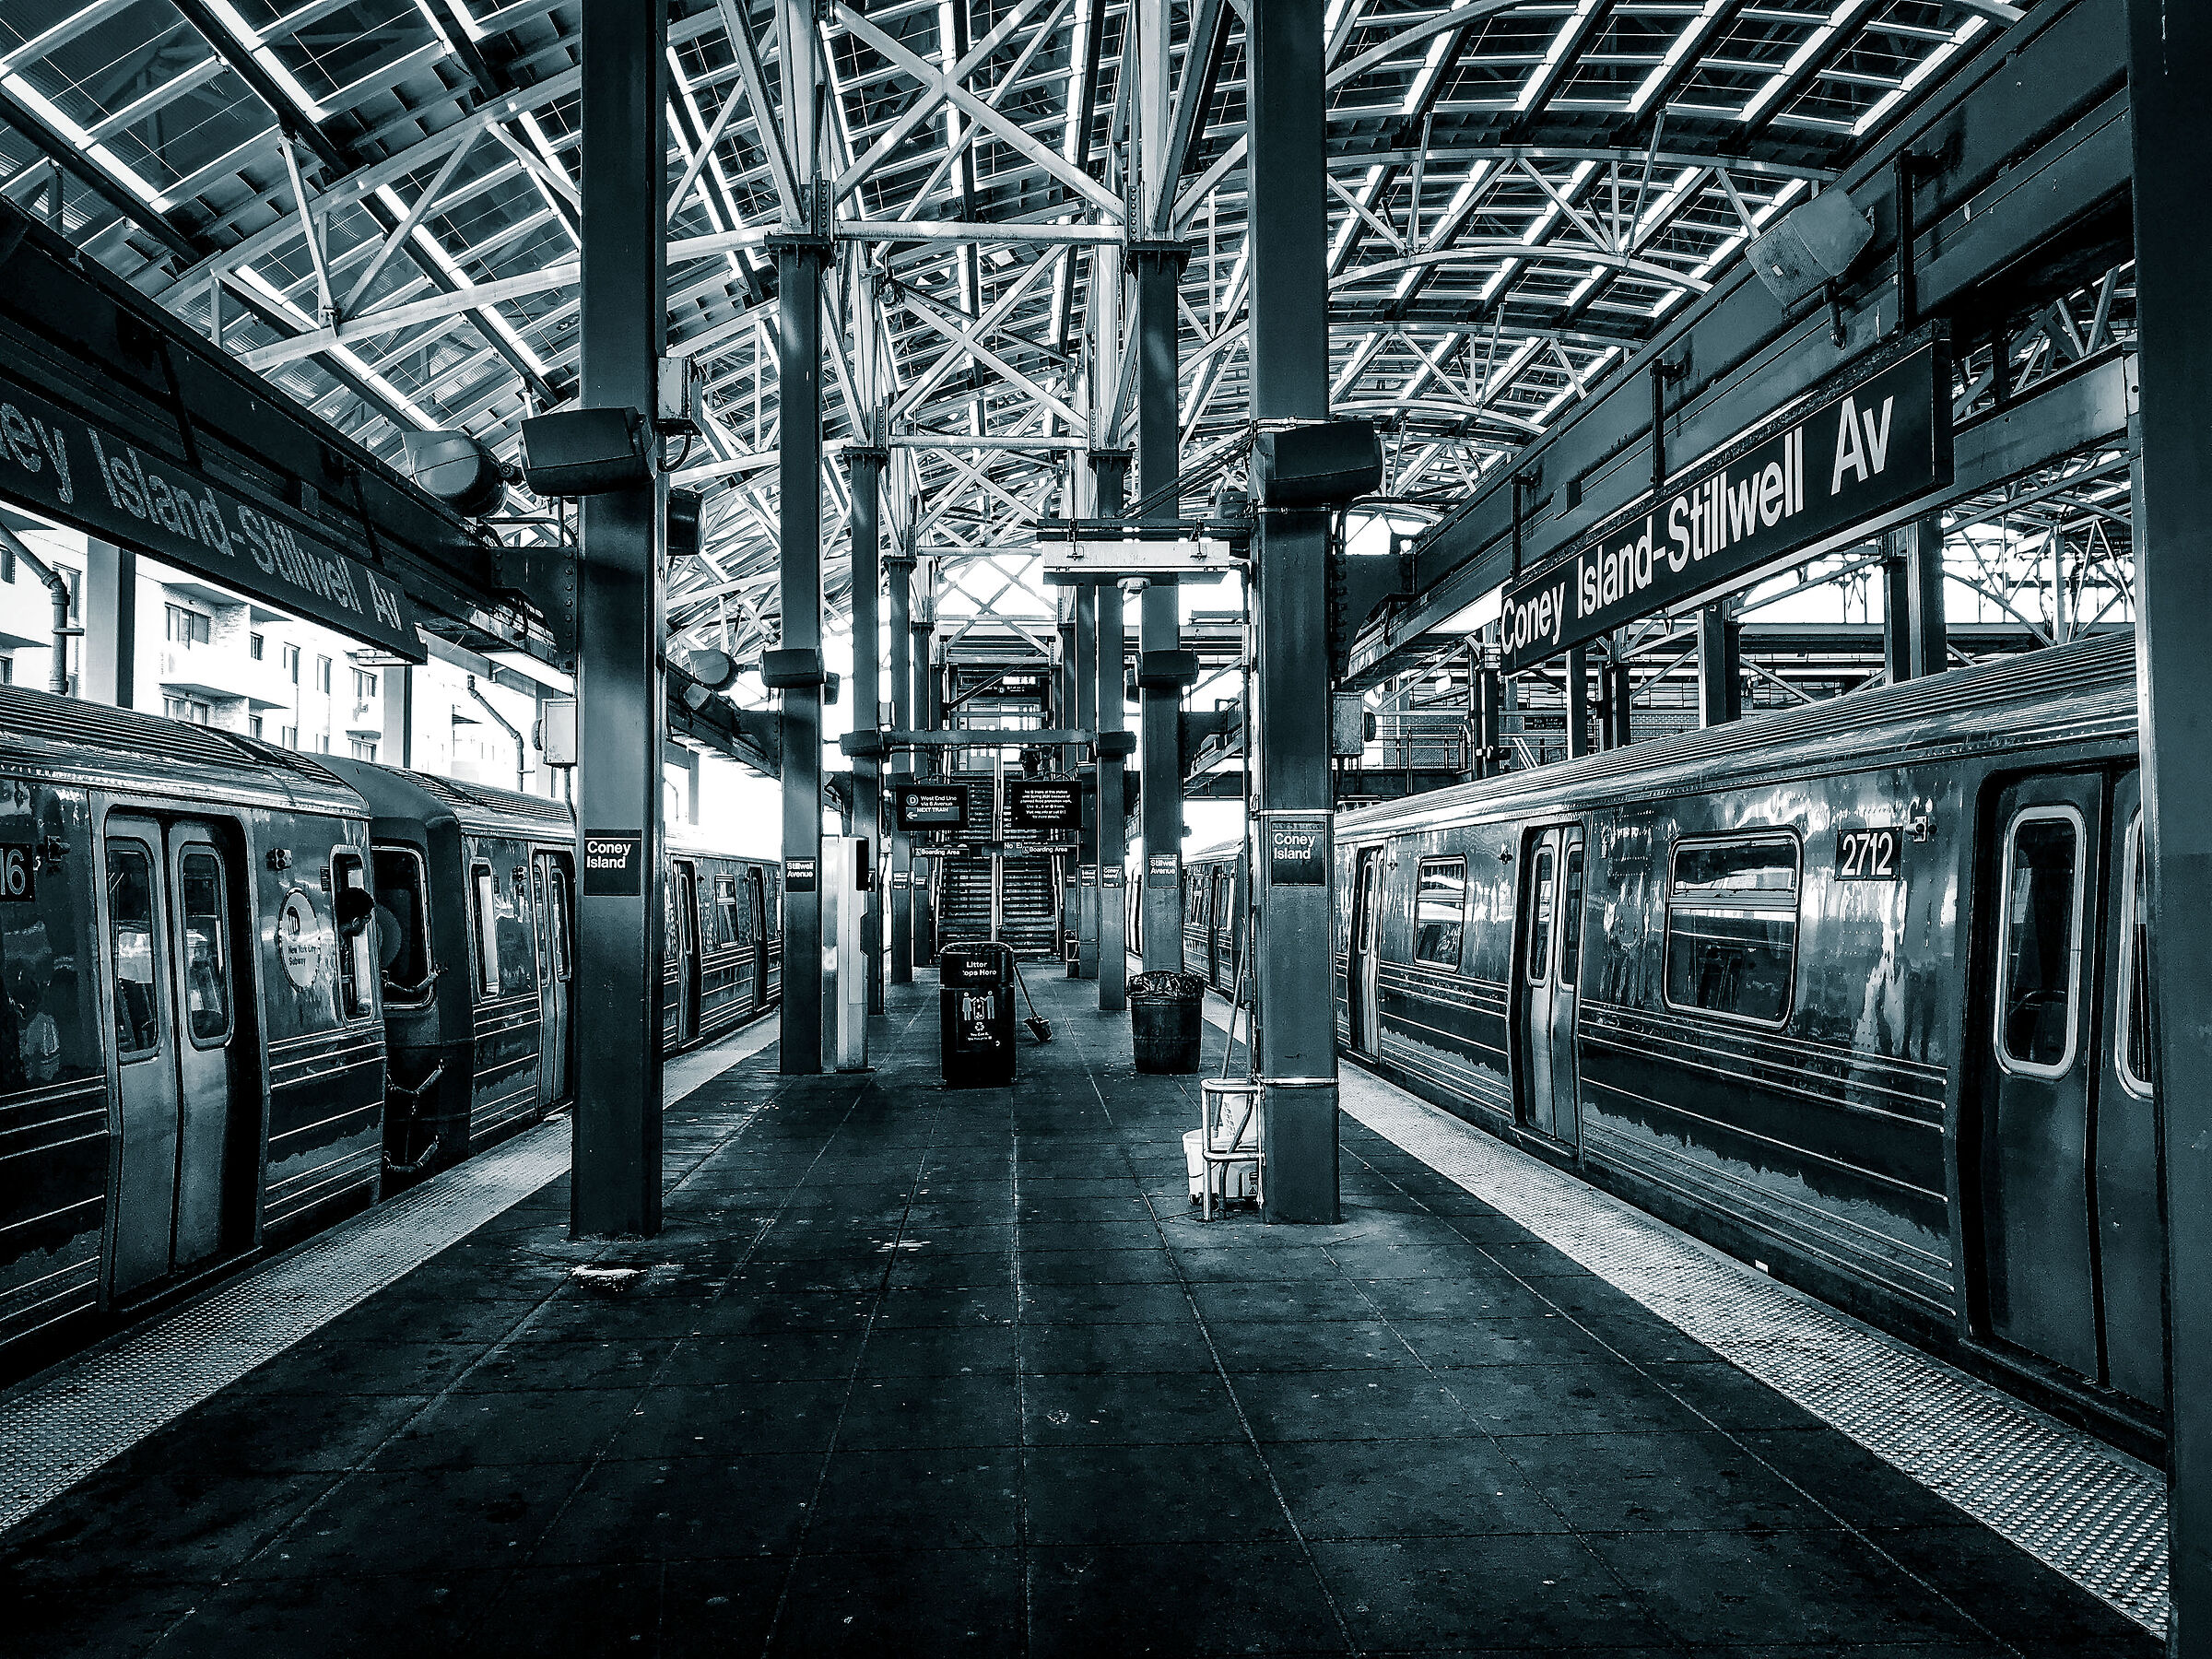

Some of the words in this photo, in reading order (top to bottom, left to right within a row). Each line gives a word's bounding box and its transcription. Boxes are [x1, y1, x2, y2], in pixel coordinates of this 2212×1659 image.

[0, 403, 73, 504] ey
[88, 428, 363, 614] Island-Stillwell
[367, 569, 403, 631] Av
[1501, 582, 1565, 654] Coney
[1577, 427, 1804, 620] Island-Stillwell
[1831, 394, 1894, 496] Av
[1274, 832, 1315, 848] Coney
[587, 841, 631, 856] Coney
[1274, 848, 1312, 860] Island
[1841, 831, 1893, 877] 2712
[586, 856, 626, 869] Island
[786, 862, 813, 870] Stillwell
[288, 945, 297, 954] New
[298, 945, 307, 953] York
[308, 945, 316, 954] City
[288, 958, 306, 966] Subway
